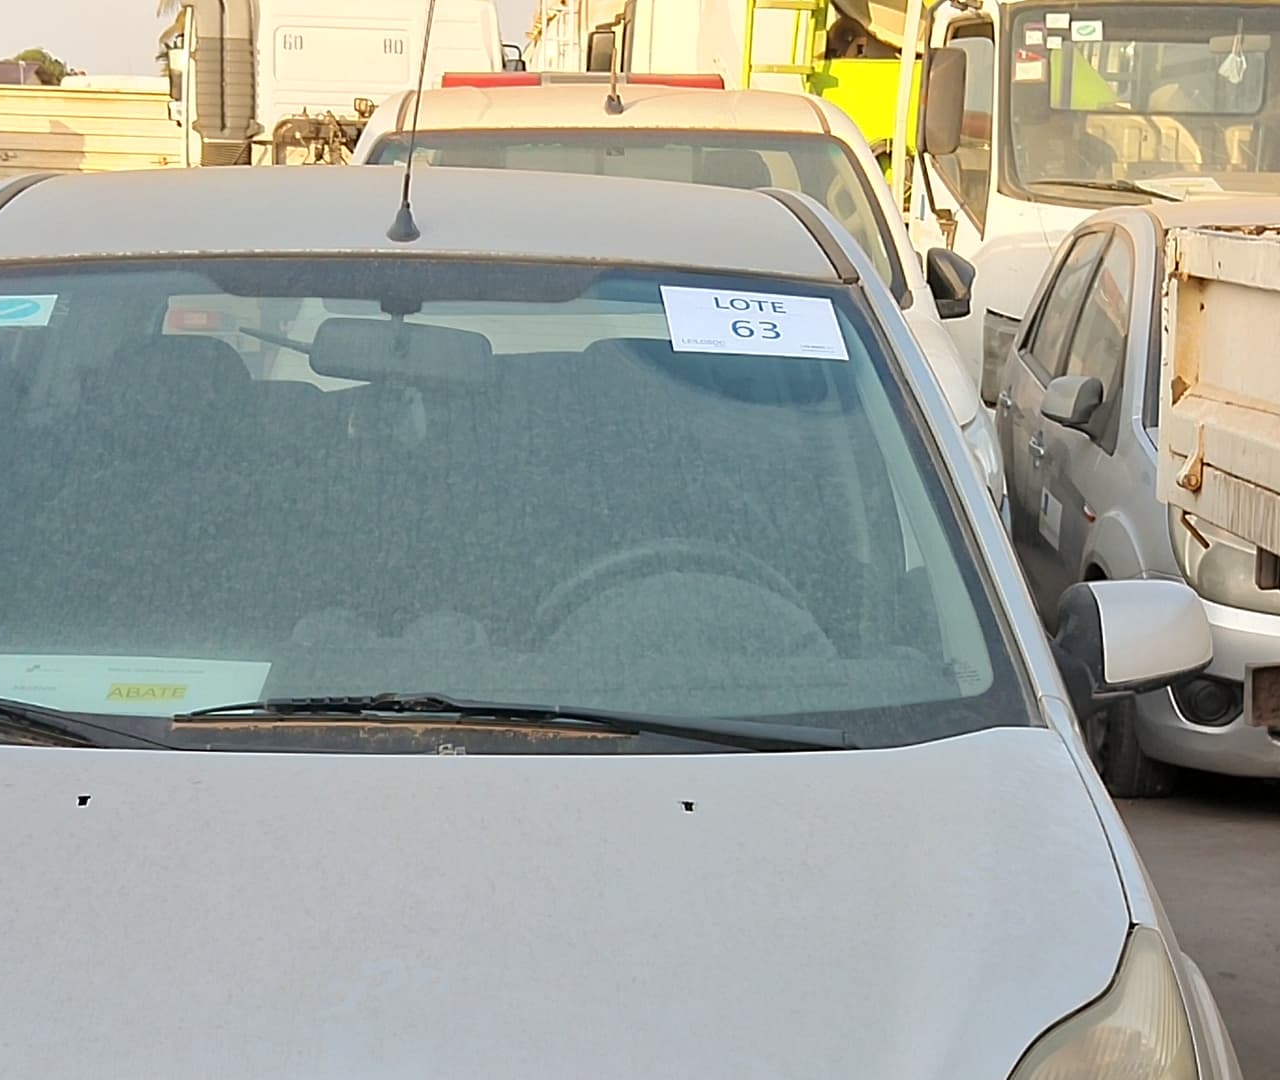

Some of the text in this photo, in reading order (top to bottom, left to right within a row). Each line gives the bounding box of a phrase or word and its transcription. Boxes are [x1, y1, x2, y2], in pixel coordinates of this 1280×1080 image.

[283, 34, 303, 51] 60
[713, 296, 787, 314] LOTE
[731, 320, 782, 340] 63
[106, 686, 187, 699] ABATE
